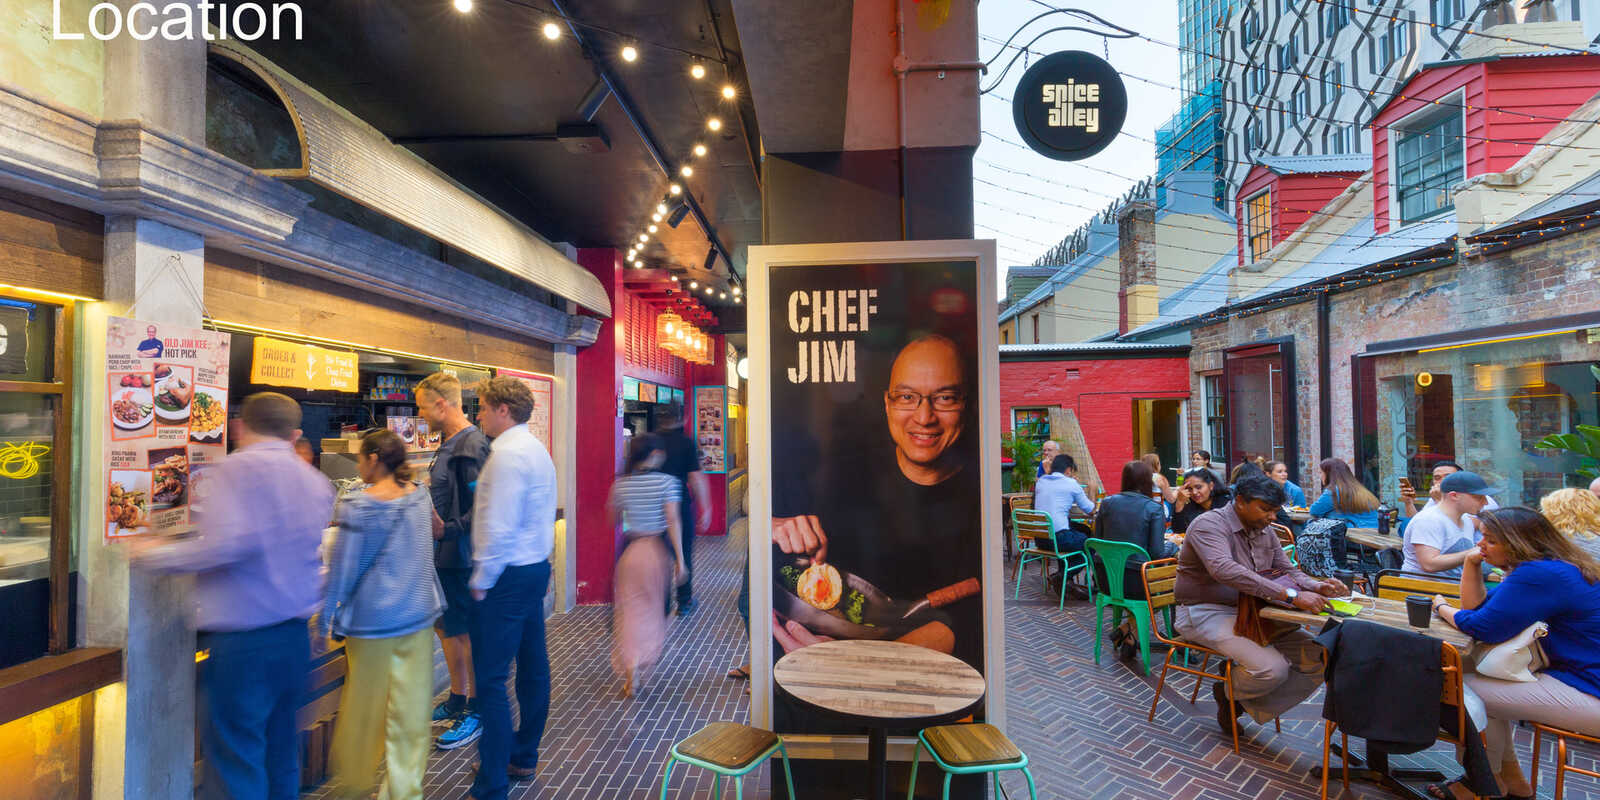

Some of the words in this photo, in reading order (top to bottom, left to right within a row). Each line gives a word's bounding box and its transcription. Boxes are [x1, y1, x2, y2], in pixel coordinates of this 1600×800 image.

[1048, 102, 1099, 132] alley
[788, 289, 878, 333] CHEF
[164, 338, 179, 348] OLD
[180, 339, 194, 349] JIM
[194, 340, 208, 350] KEE
[165, 349, 179, 358] HOT
[181, 349, 197, 359] PICK
[262, 347, 289, 363] ORDER
[788, 340, 856, 383] JIM
[261, 364, 295, 379] COLLECT
